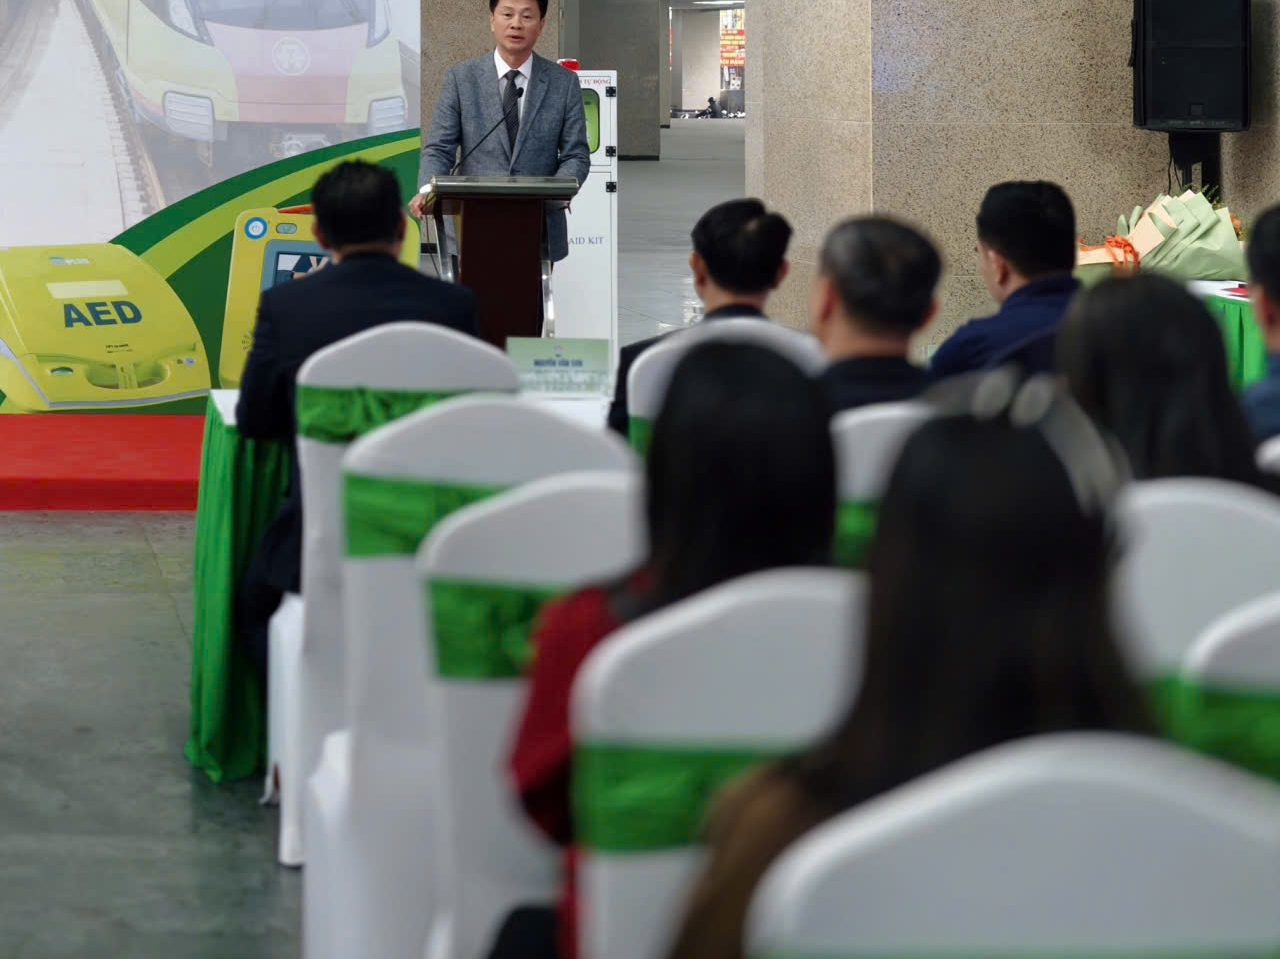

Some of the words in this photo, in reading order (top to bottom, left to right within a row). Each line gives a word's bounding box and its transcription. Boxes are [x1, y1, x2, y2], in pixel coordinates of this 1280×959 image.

[568, 236, 586, 245] AID
[587, 236, 605, 245] KIT
[63, 300, 143, 328] AED
